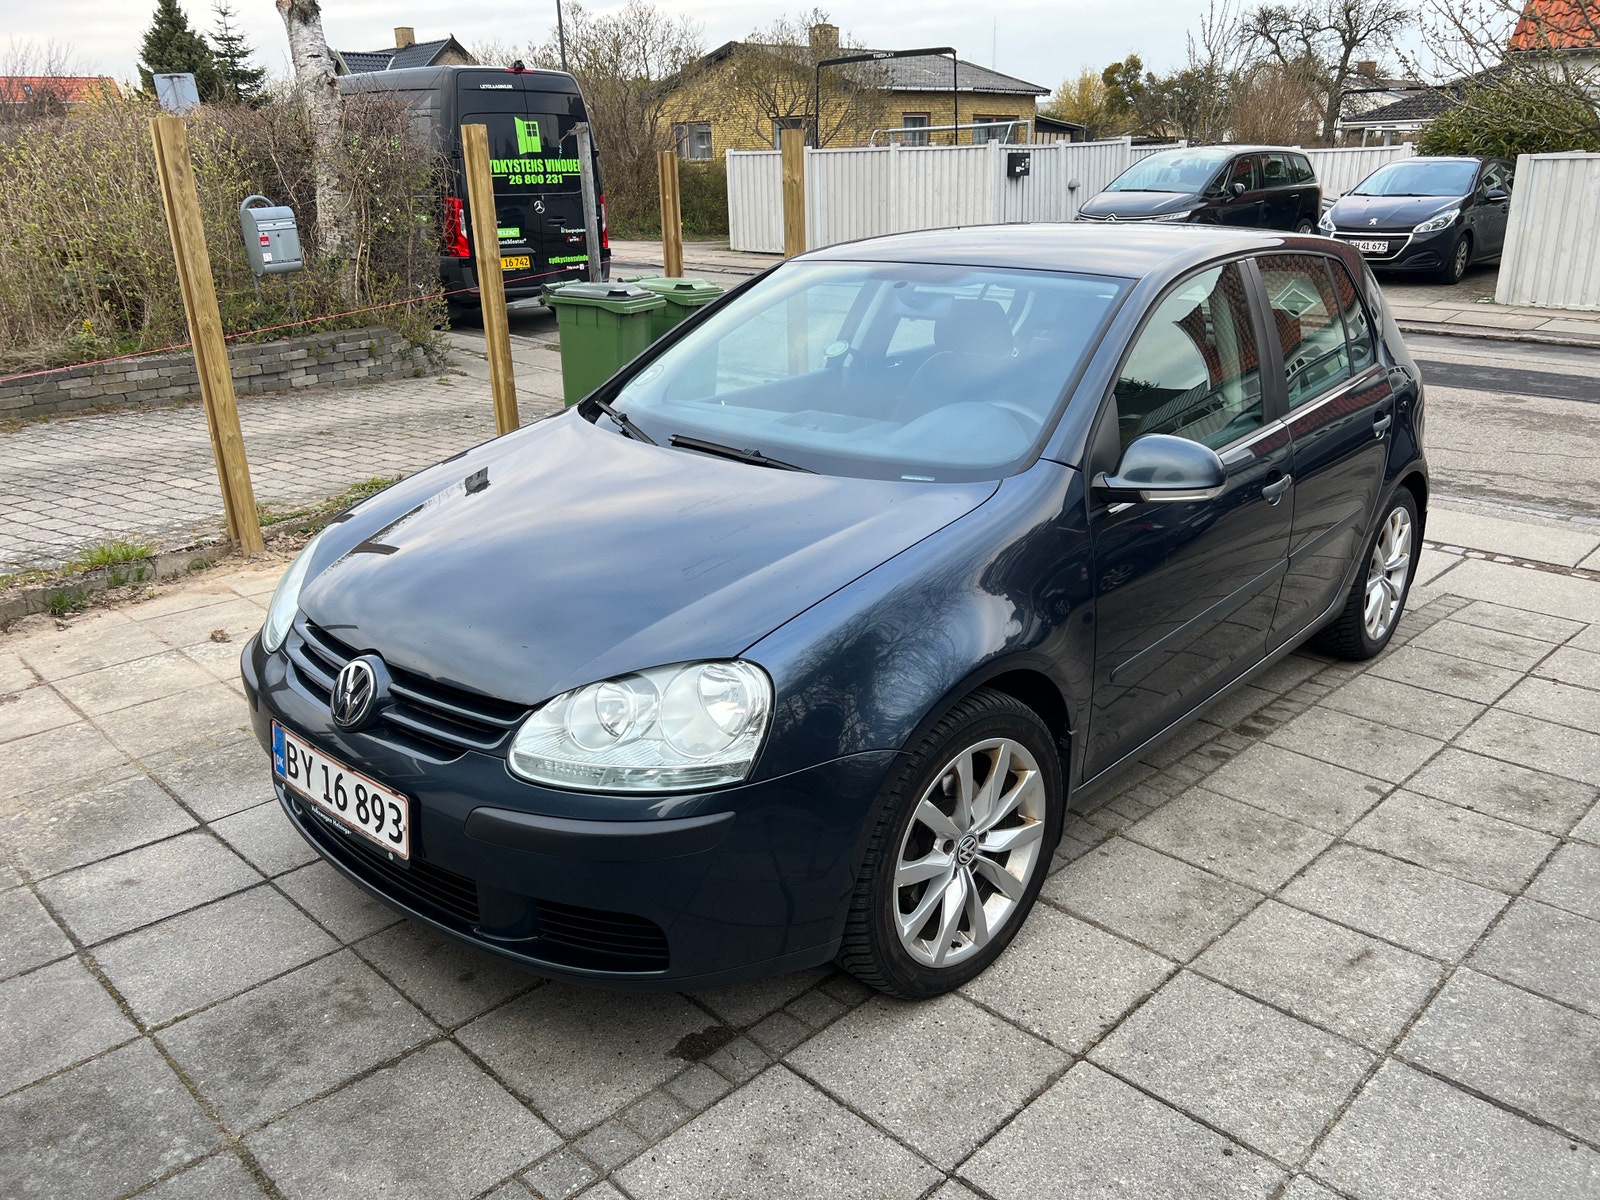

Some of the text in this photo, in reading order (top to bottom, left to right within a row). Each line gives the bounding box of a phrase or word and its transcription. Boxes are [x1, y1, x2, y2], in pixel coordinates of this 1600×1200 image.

[508, 173, 563, 185] 26 800 231
[1371, 242, 1387, 250] 675
[504, 257, 529, 268] 16 742
[276, 754, 285, 769] DK
[286, 740, 403, 844] BY 16 893
